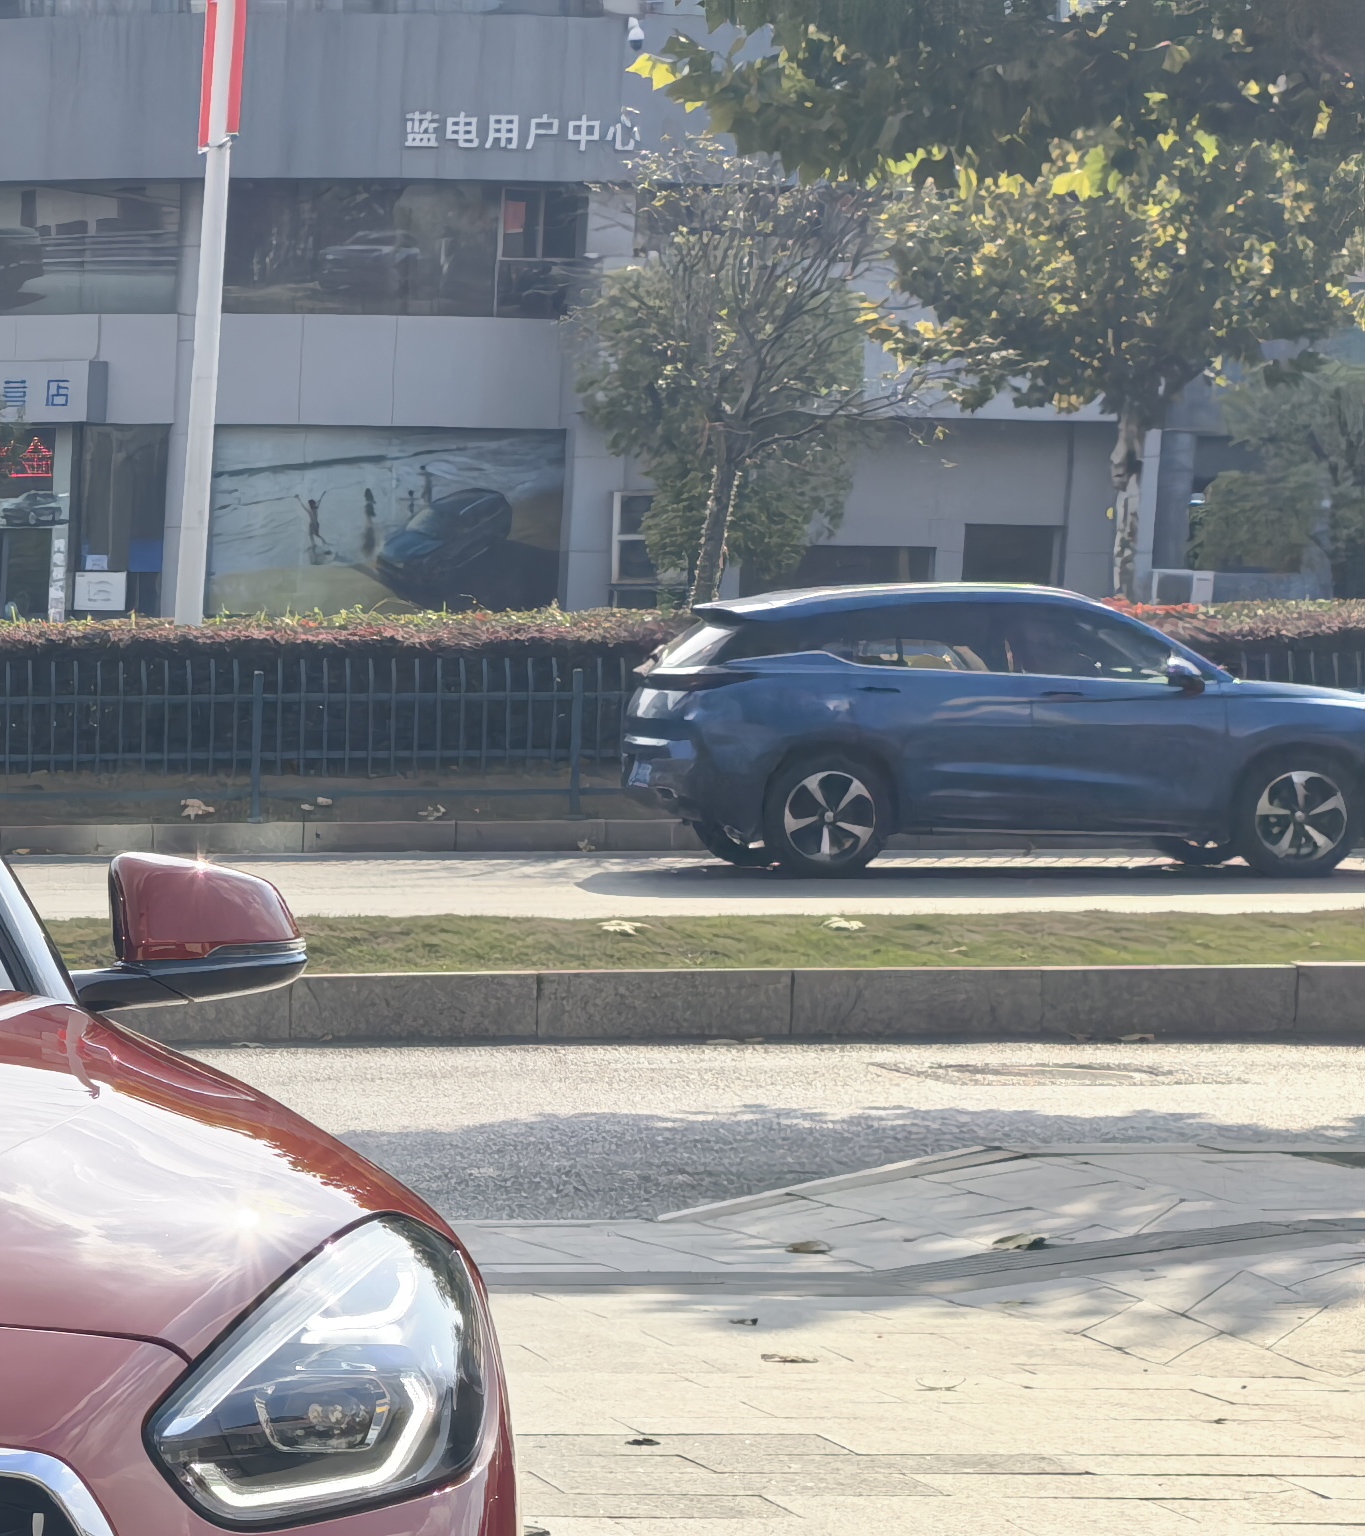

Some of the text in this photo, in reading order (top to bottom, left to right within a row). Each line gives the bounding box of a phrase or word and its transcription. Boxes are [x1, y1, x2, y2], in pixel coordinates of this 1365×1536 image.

[404, 110, 642, 152] 蓝电用户中心
